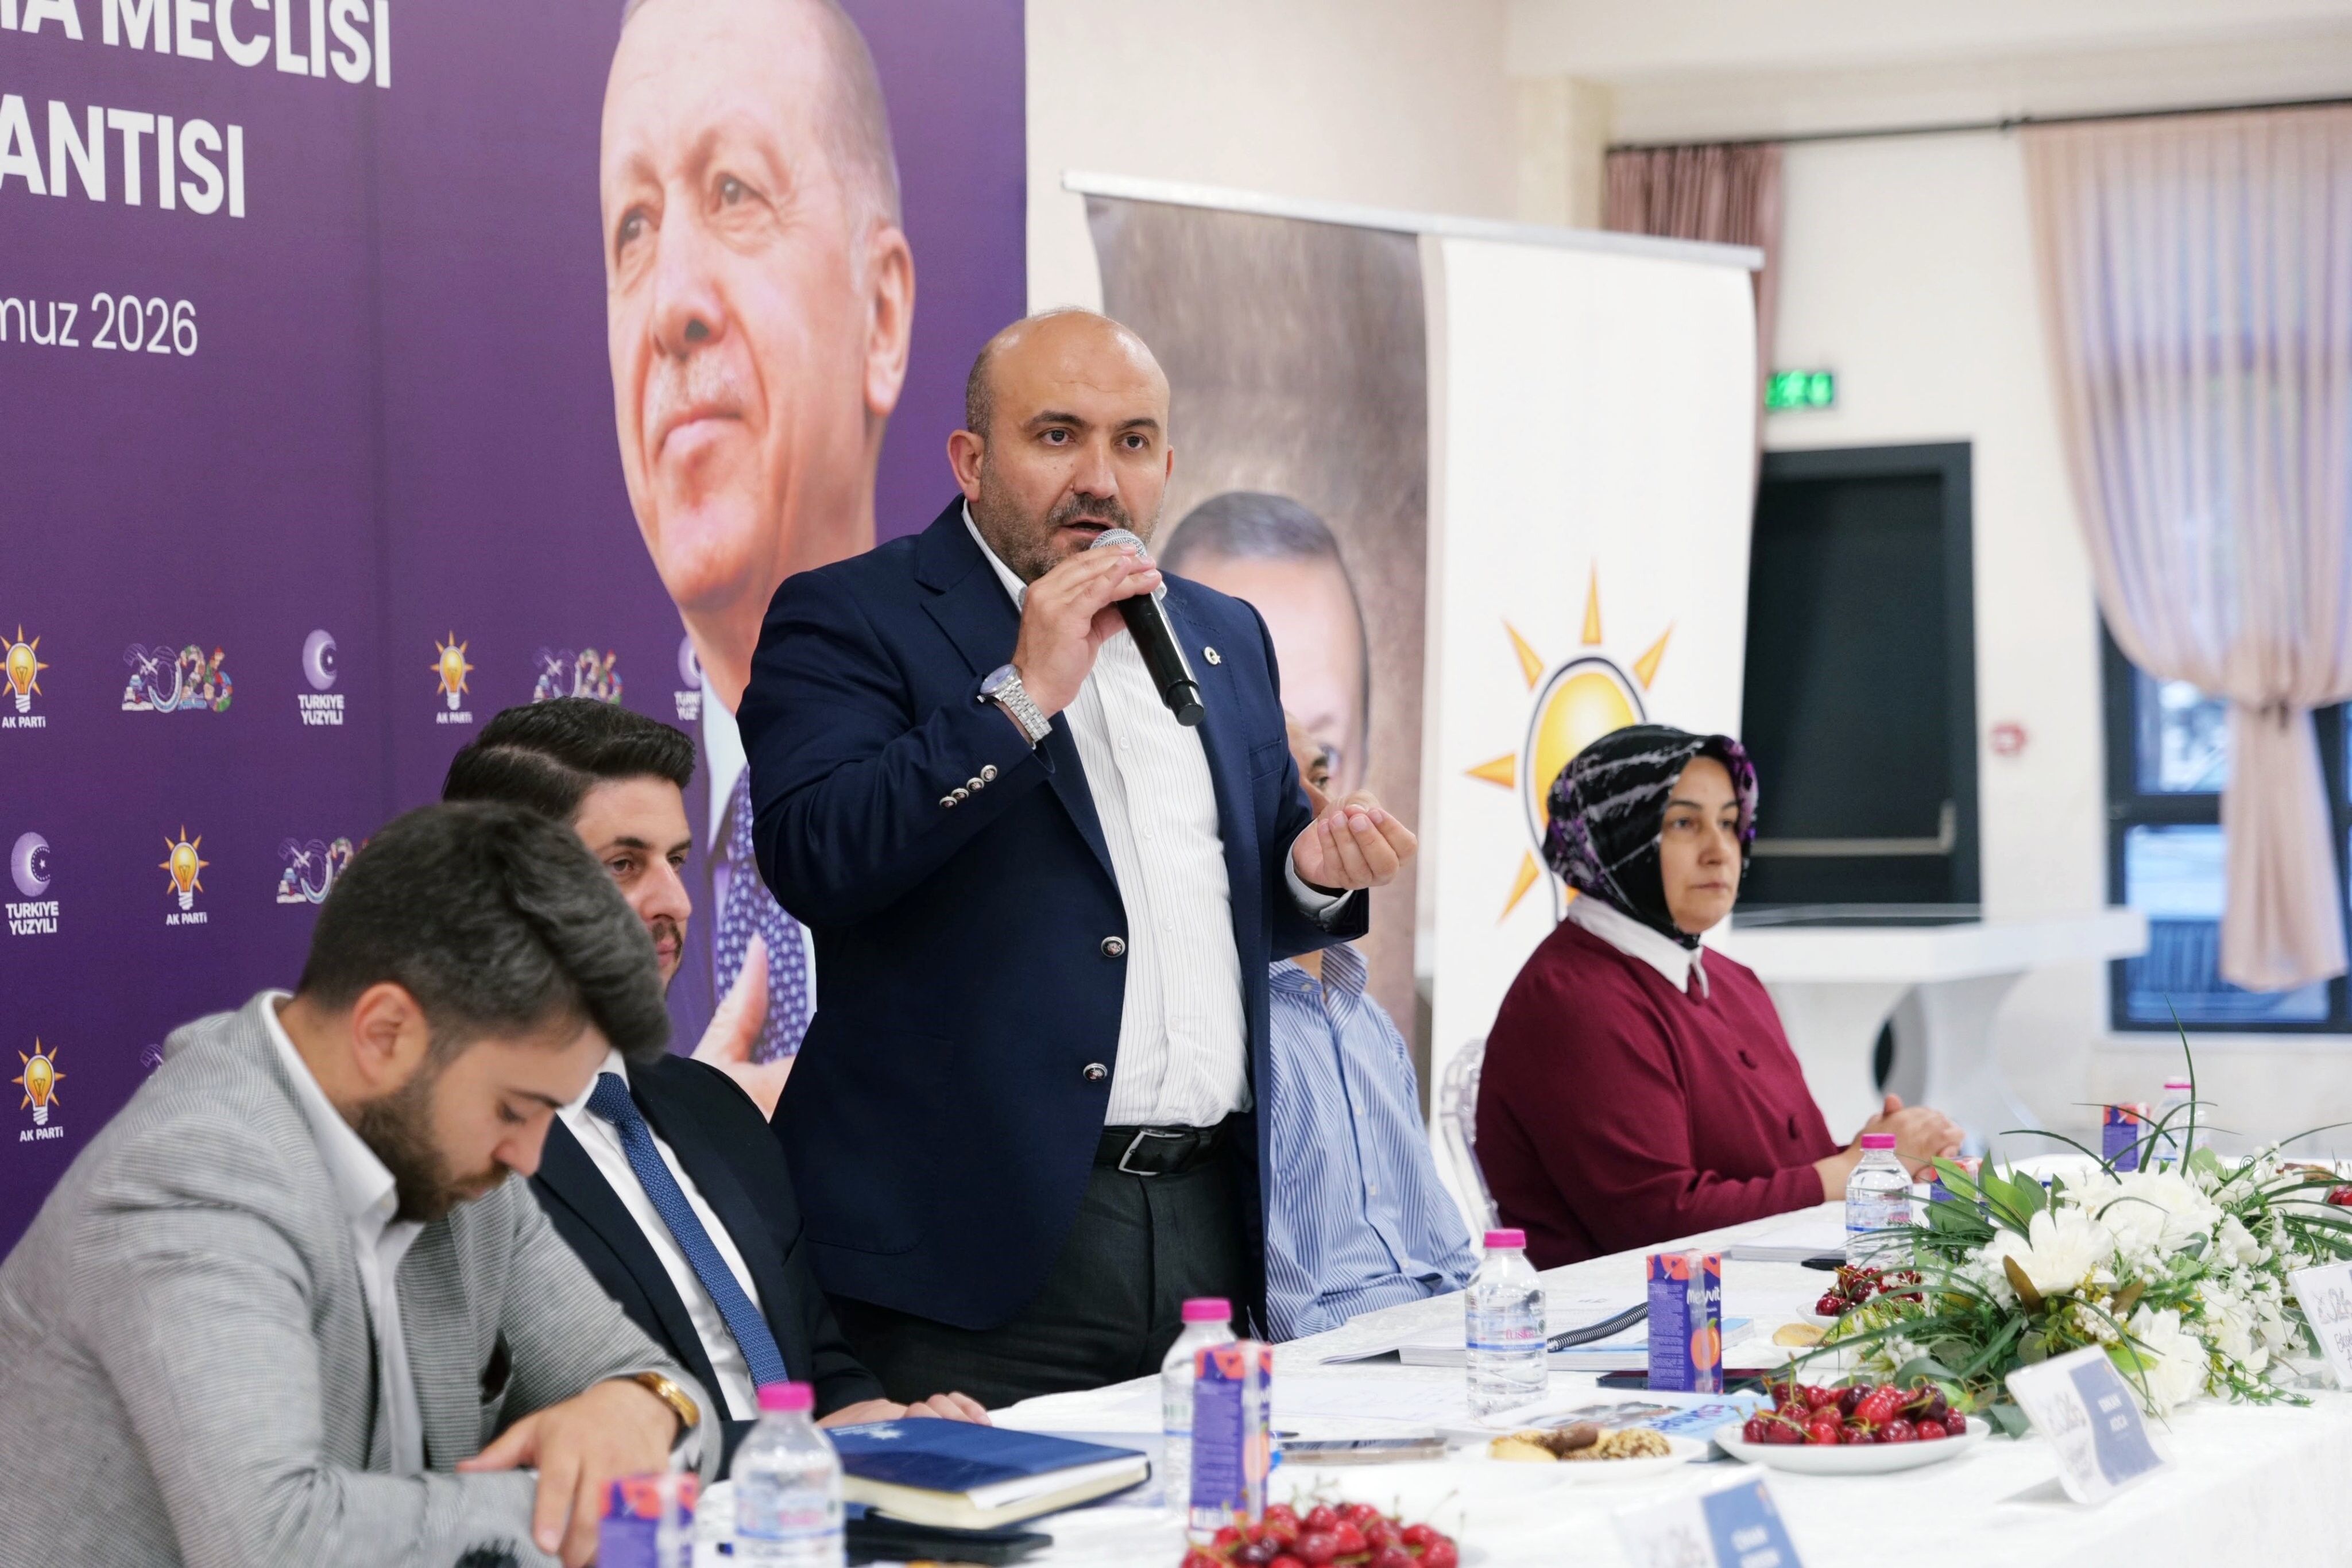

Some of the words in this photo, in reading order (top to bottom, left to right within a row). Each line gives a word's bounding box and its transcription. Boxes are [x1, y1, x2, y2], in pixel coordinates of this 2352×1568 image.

[91, 292, 198, 357] 2026
[2, 716, 17, 729] AK
[166, 913, 180, 926] AK
[20, 1129, 34, 1143] AK
